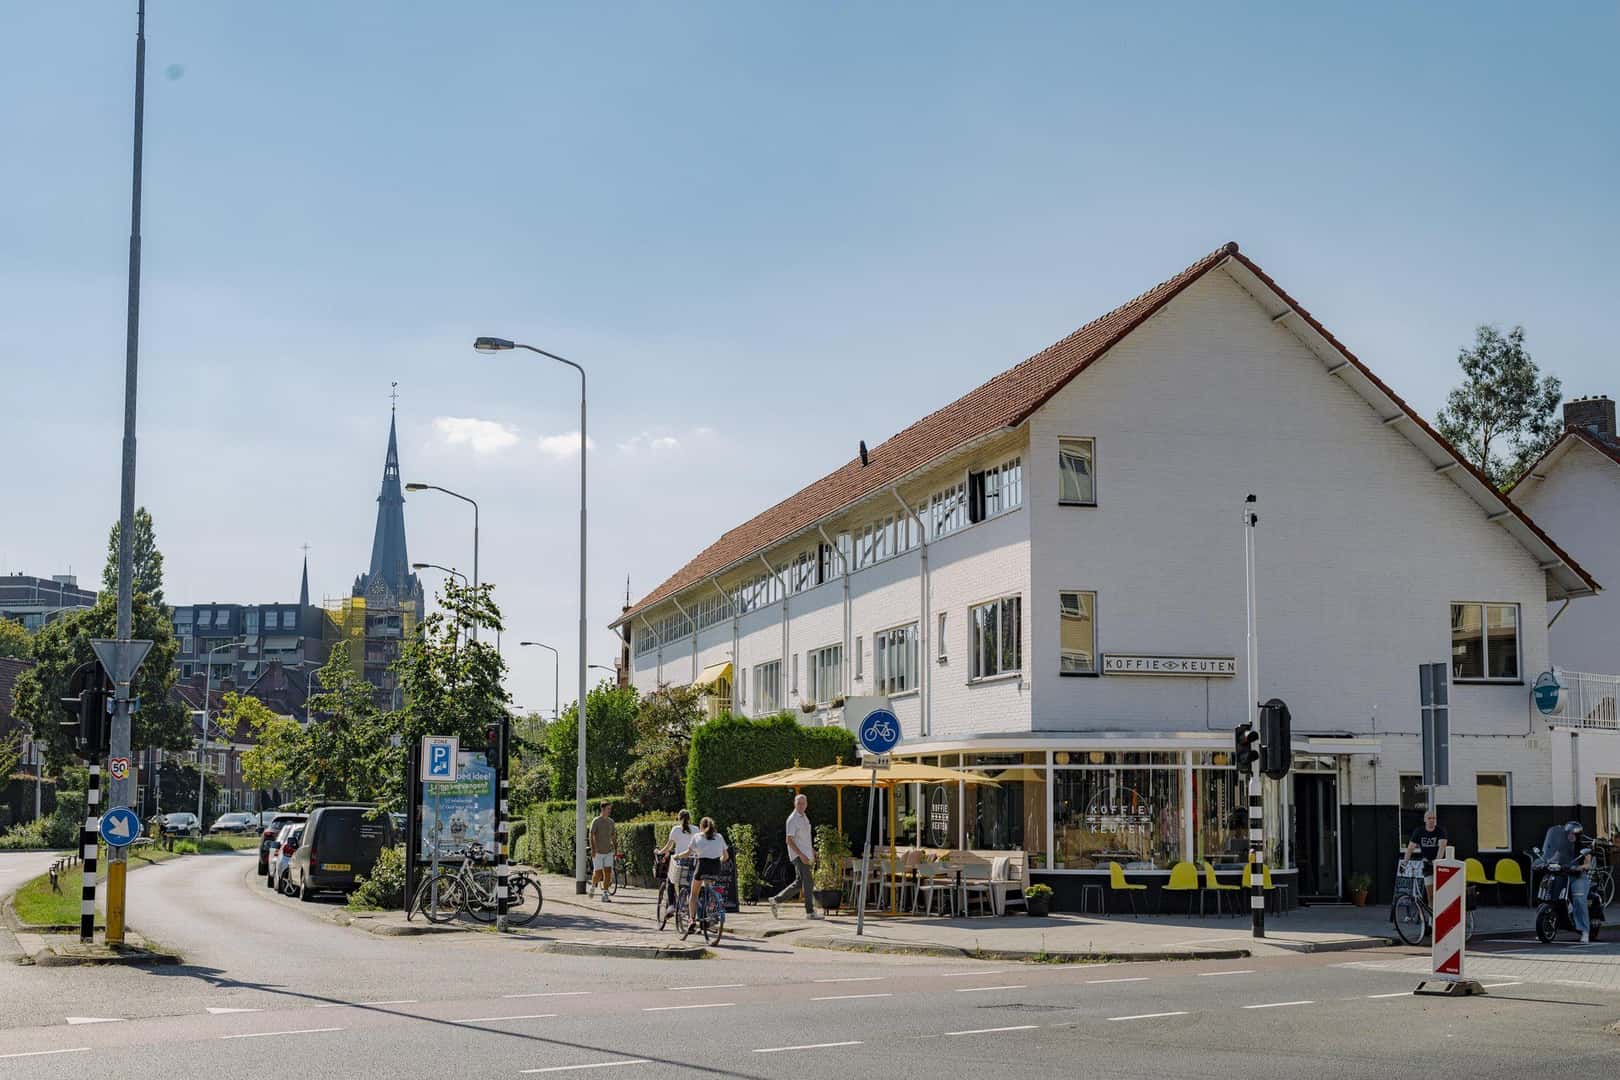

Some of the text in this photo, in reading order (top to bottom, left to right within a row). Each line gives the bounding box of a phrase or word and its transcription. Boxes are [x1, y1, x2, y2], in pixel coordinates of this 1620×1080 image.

[1106, 659, 1235, 671] KOFFIE KEUTEN
[434, 747, 446, 763] P
[113, 763, 126, 772] 50
[932, 803, 948, 812] KOFFIE
[1090, 805, 1145, 815] KOFFIE
[1090, 824, 1145, 834] KEUTEN
